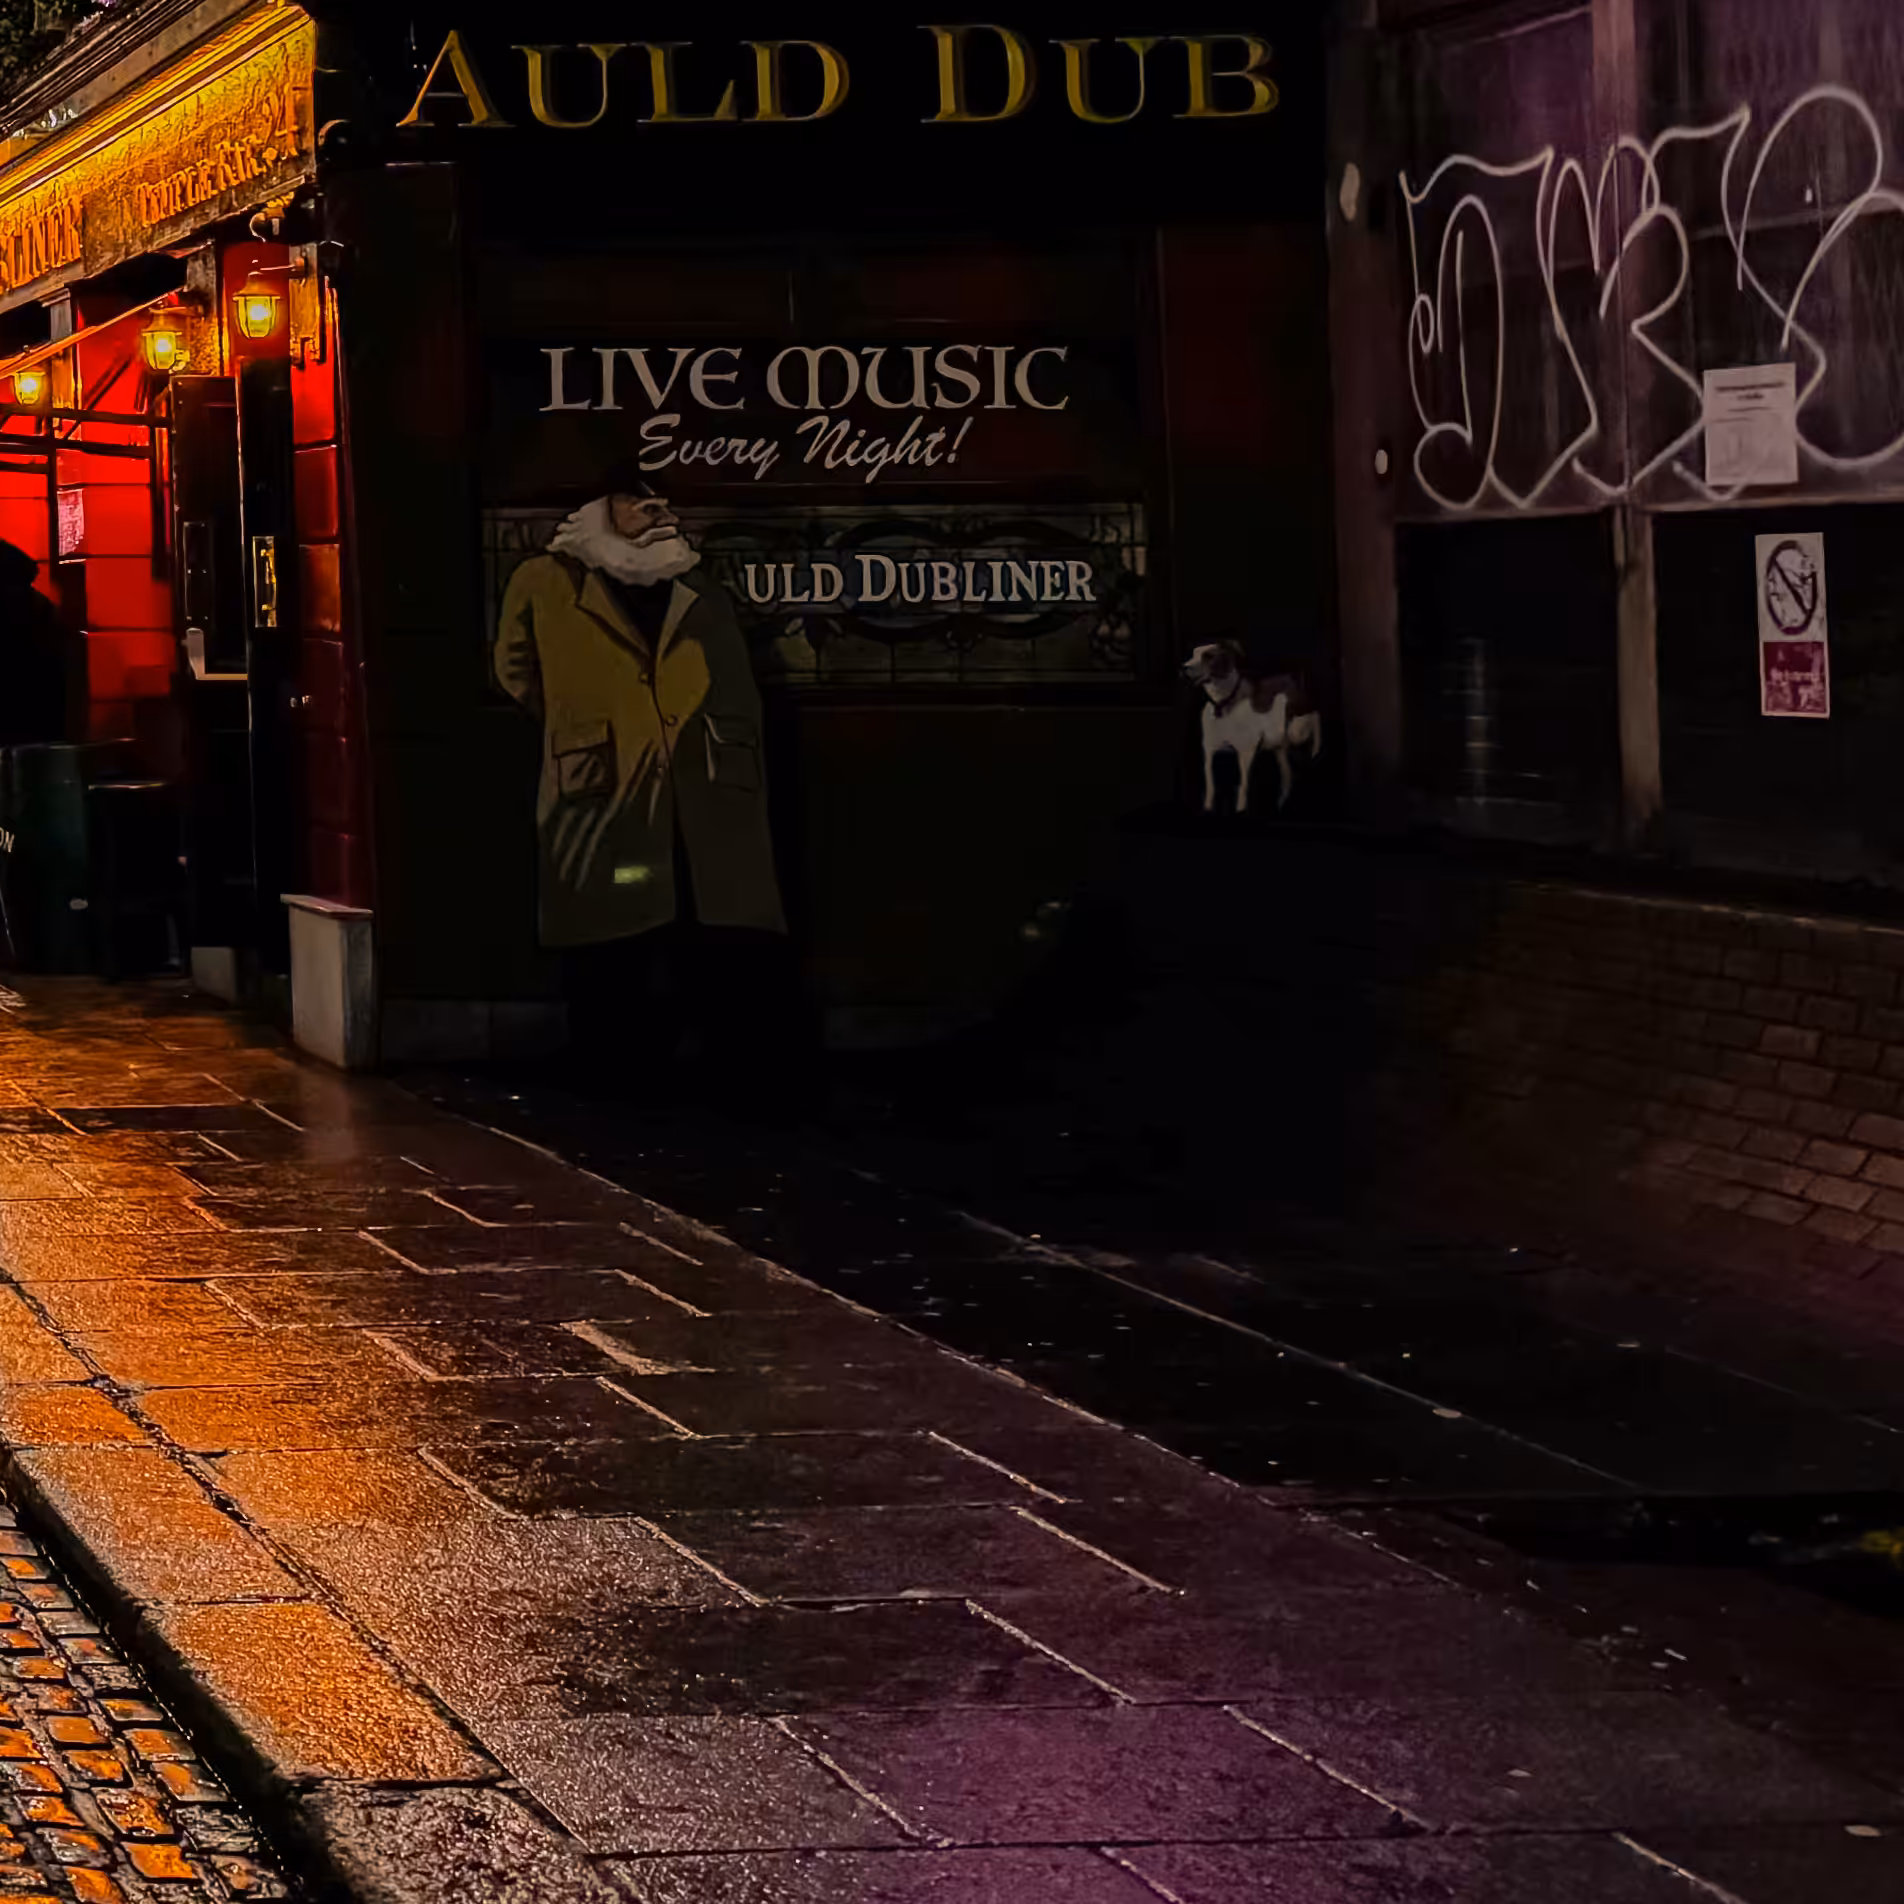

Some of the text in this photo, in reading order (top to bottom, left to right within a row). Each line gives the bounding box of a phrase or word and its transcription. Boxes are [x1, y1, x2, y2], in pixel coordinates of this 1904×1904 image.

[395, 24, 1281, 131] AULD DUB
[539, 343, 1070, 412] LIVE MUSIC
[637, 412, 976, 485] Every Night!
[744, 552, 1097, 606] ULD DUBLINER
